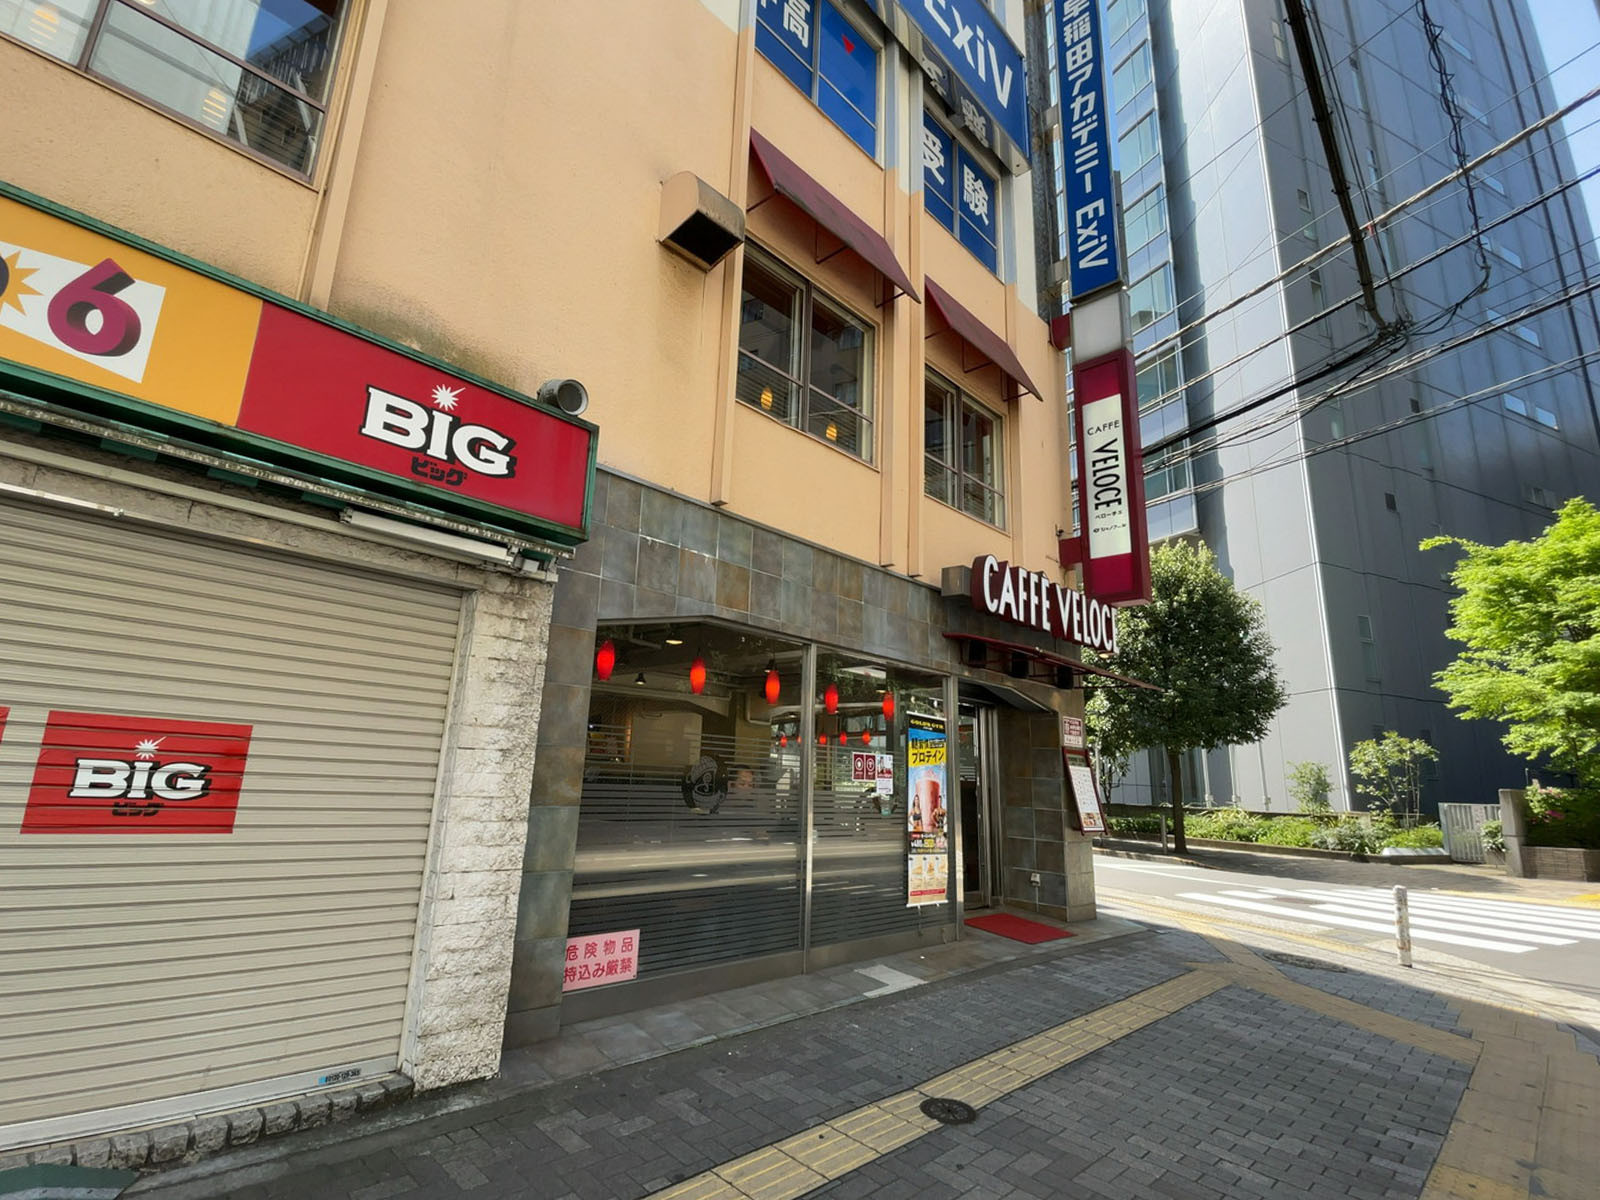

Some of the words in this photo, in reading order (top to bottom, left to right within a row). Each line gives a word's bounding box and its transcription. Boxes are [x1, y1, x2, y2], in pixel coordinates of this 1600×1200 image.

[1075, 198, 1109, 269] ExiV
[359, 384, 517, 478] BIG
[411, 456, 468, 486] ビッグ
[1092, 438, 1122, 510] VELOCE
[67, 757, 212, 800] BIG
[563, 957, 633, 984] 持込み厳禁
[565, 937, 633, 962] 危険物品
